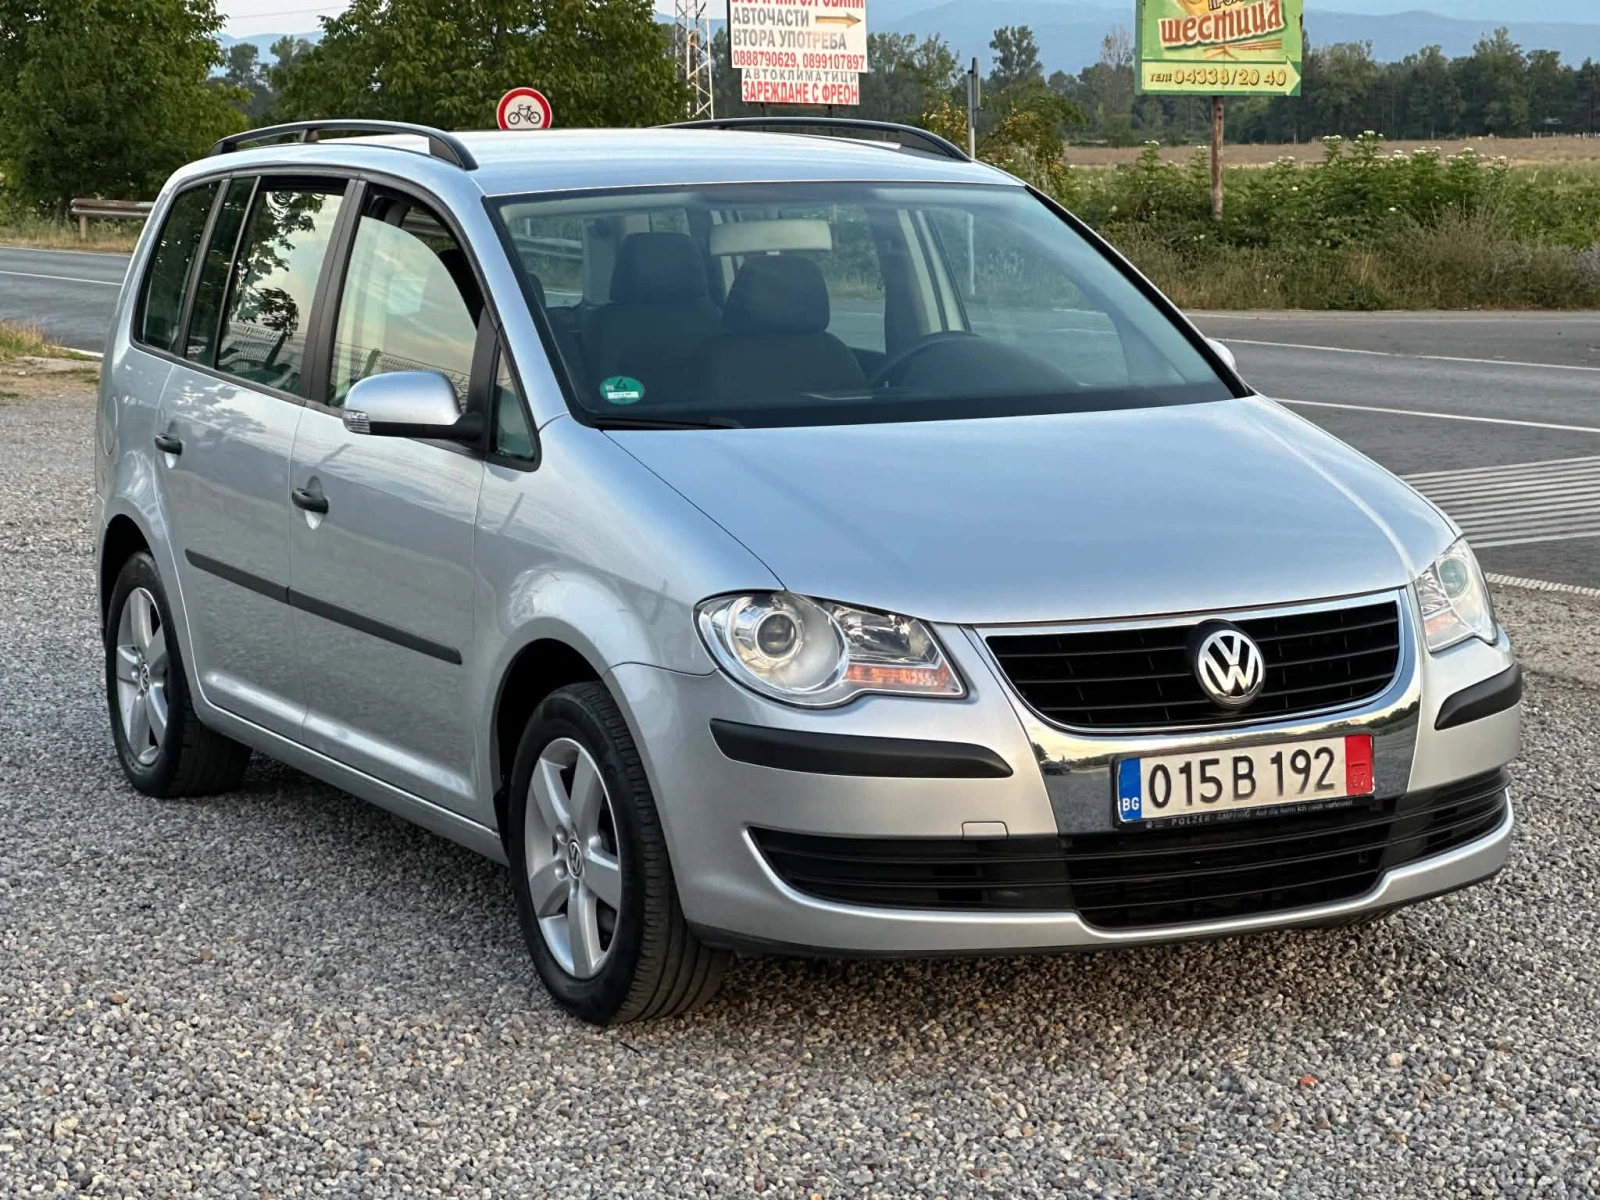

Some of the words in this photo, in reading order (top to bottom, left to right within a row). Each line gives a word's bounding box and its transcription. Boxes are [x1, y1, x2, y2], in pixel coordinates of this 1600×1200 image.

[732, 7, 810, 27] АВТОЧАСТИ
[1160, 0, 1283, 43] шестица
[733, 28, 776, 48] ВТОРА
[779, 30, 847, 50] УПОТРЕБА
[802, 53, 865, 70] 0899107897
[744, 69, 857, 83] АВТОКЛИМАТИЦИ
[1264, 69, 1287, 87] 40
[743, 81, 808, 102] ЗАРЕЖДАНЕ
[812, 83, 819, 102] С
[822, 84, 858, 104] ФРЕОН
[1149, 758, 1223, 808] 015
[1232, 755, 1256, 801] B
[1270, 746, 1335, 797] 192
[1122, 797, 1140, 812] BG
